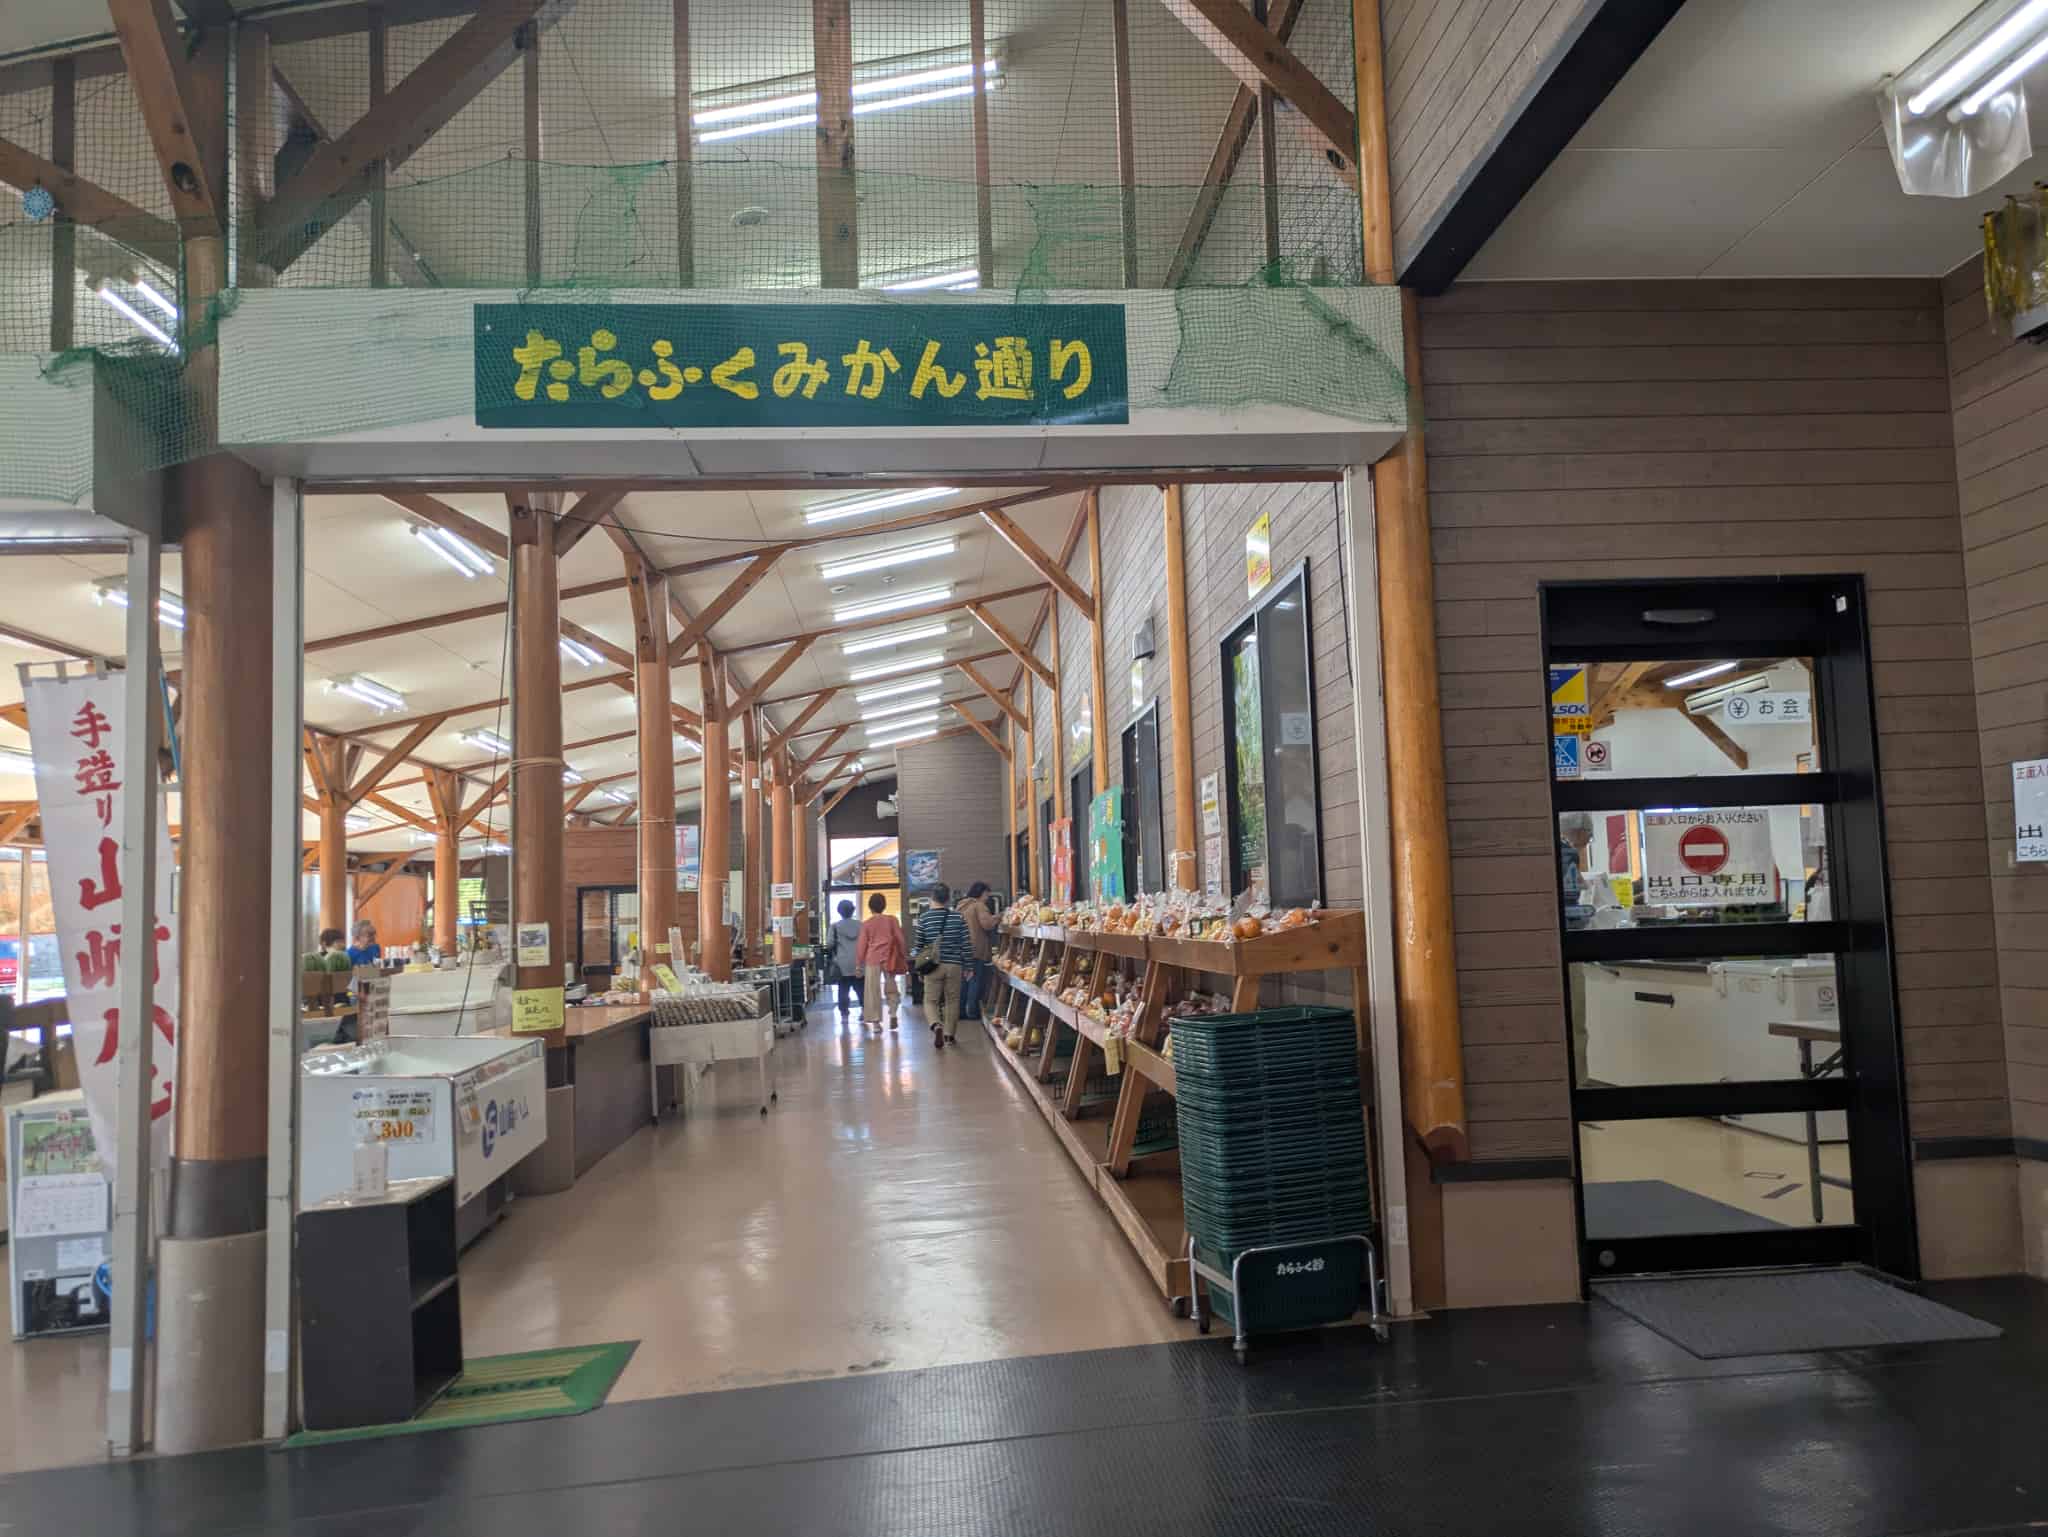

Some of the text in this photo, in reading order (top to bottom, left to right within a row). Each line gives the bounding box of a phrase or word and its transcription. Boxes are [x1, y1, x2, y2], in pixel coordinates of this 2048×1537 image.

[512, 327, 1093, 402] たらふくみかん通り
[1758, 697, 1811, 716] お会
[2015, 765, 2048, 781] 正面入
[1649, 872, 1767, 889] 出口専用
